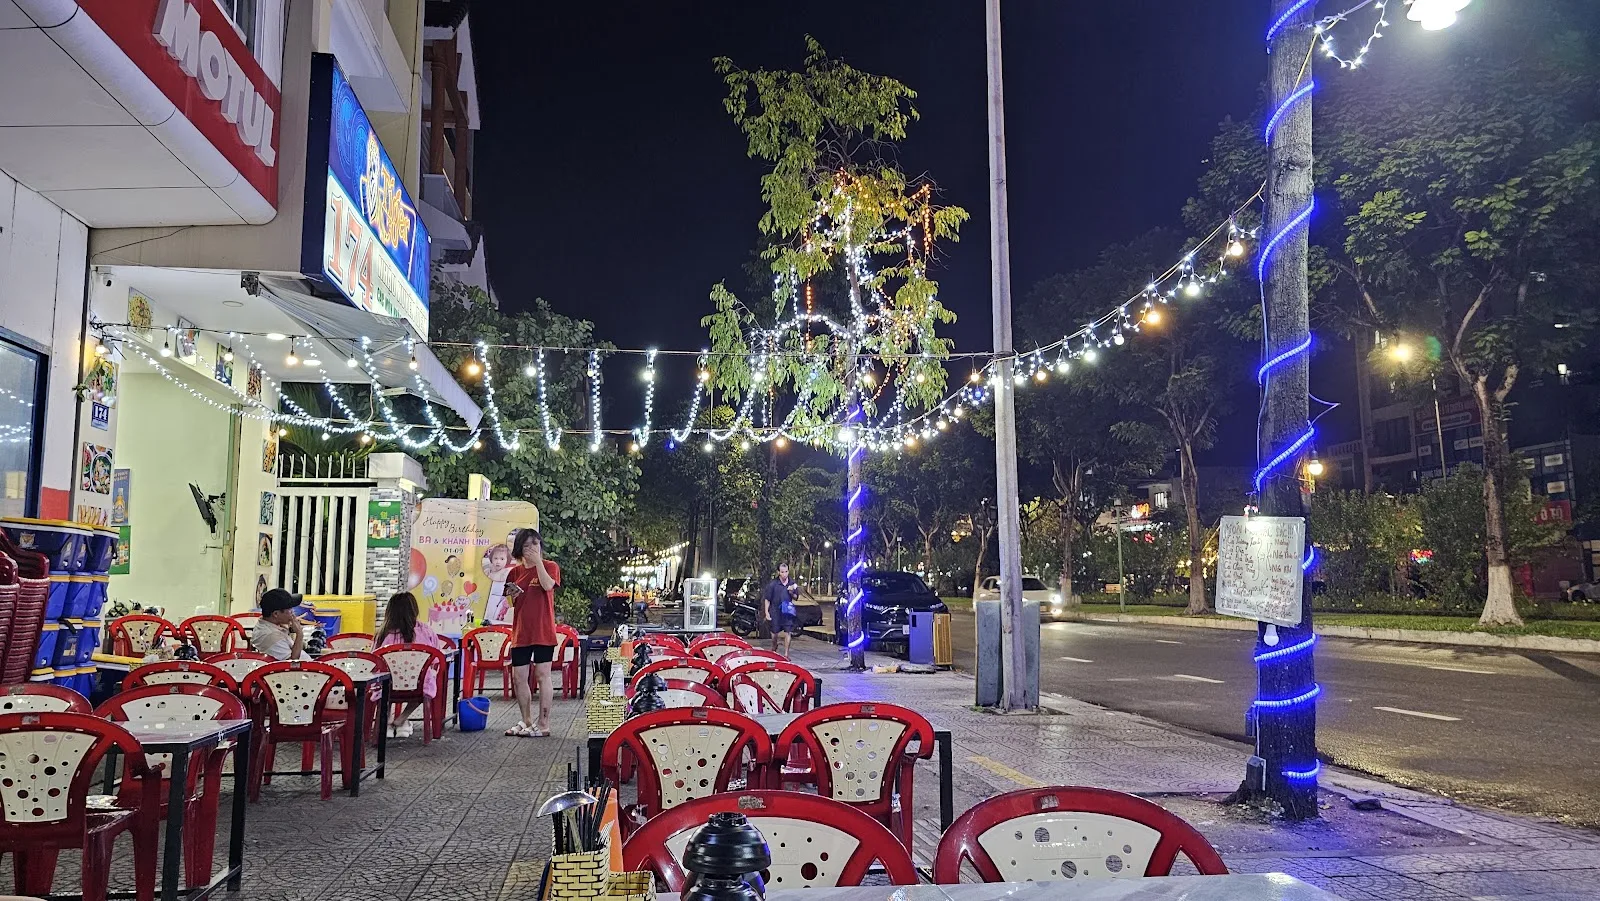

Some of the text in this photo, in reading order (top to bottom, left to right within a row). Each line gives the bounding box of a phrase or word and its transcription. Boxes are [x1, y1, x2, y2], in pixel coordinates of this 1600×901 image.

[152, 0, 276, 167] MOTUL
[379, 164, 411, 248] Tiger
[328, 192, 374, 312] 174
[95, 406, 107, 420] 174
[422, 516, 450, 530] Happy
[448, 524, 484, 537] Birthday
[472, 538, 490, 546] LINH
